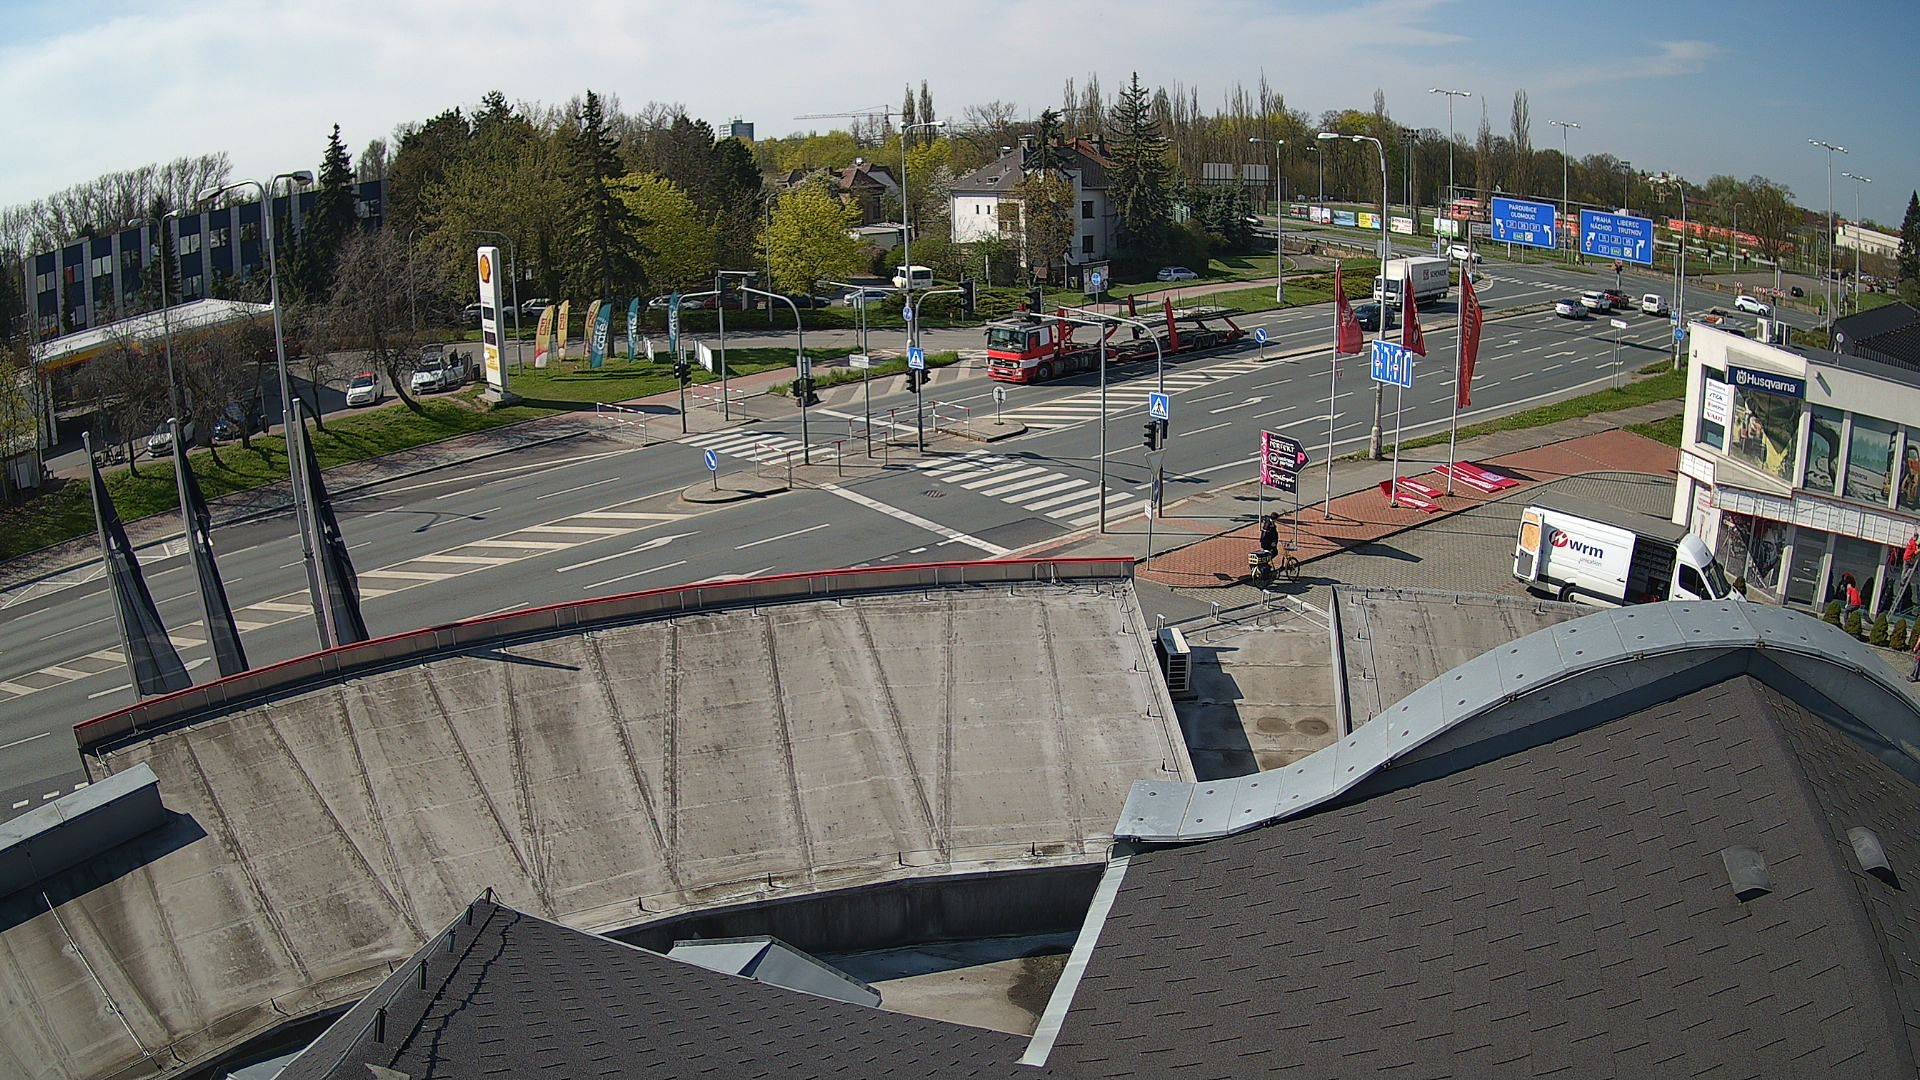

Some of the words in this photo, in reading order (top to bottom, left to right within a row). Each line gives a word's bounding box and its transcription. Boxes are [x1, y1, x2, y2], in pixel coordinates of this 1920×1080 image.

[1508, 203, 1537, 213] PARDUBICE
[1510, 211, 1535, 220] OLOMOUC
[1593, 215, 1611, 224] PRAHA
[1617, 219, 1639, 228] LIBEREC
[1590, 222, 1612, 232] NÁCHOD
[1618, 226, 1642, 237] TRUTNOV
[1747, 373, 1795, 393] Husqvarna
[1570, 540, 1603, 558] wrm
